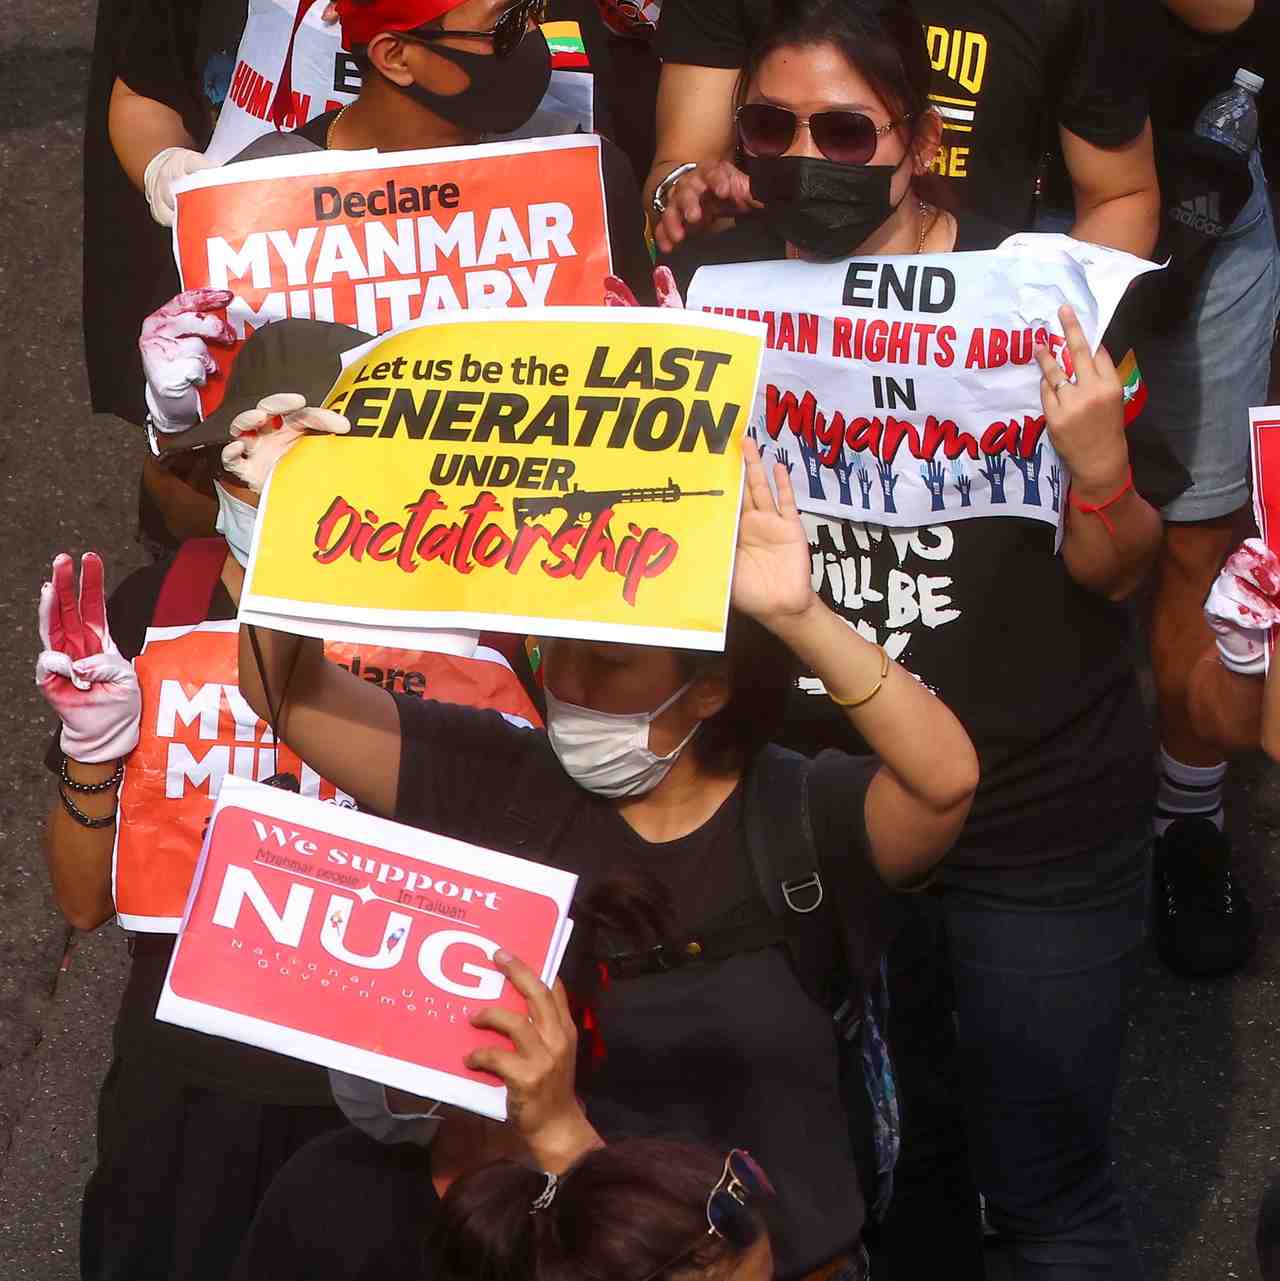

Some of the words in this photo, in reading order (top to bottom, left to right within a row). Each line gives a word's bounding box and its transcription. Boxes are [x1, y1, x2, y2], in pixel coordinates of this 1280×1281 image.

[313, 180, 460, 222] Declare
[206, 202, 577, 292] MYANMAR
[842, 262, 955, 313] END
[413, 359, 452, 382] us
[460, 353, 501, 384] be
[512, 355, 568, 386] the
[584, 346, 732, 392] LAST
[832, 317, 956, 368] RIGHTS
[872, 376, 916, 411] IN
[766, 384, 1047, 469] Myanmar
[430, 453, 576, 491] UNDER
[313, 489, 679, 606] Dictatorship
[886, 569, 962, 629] BE
[253, 820, 317, 856] We
[327, 848, 503, 911] support
[212, 863, 506, 1000] NUG
